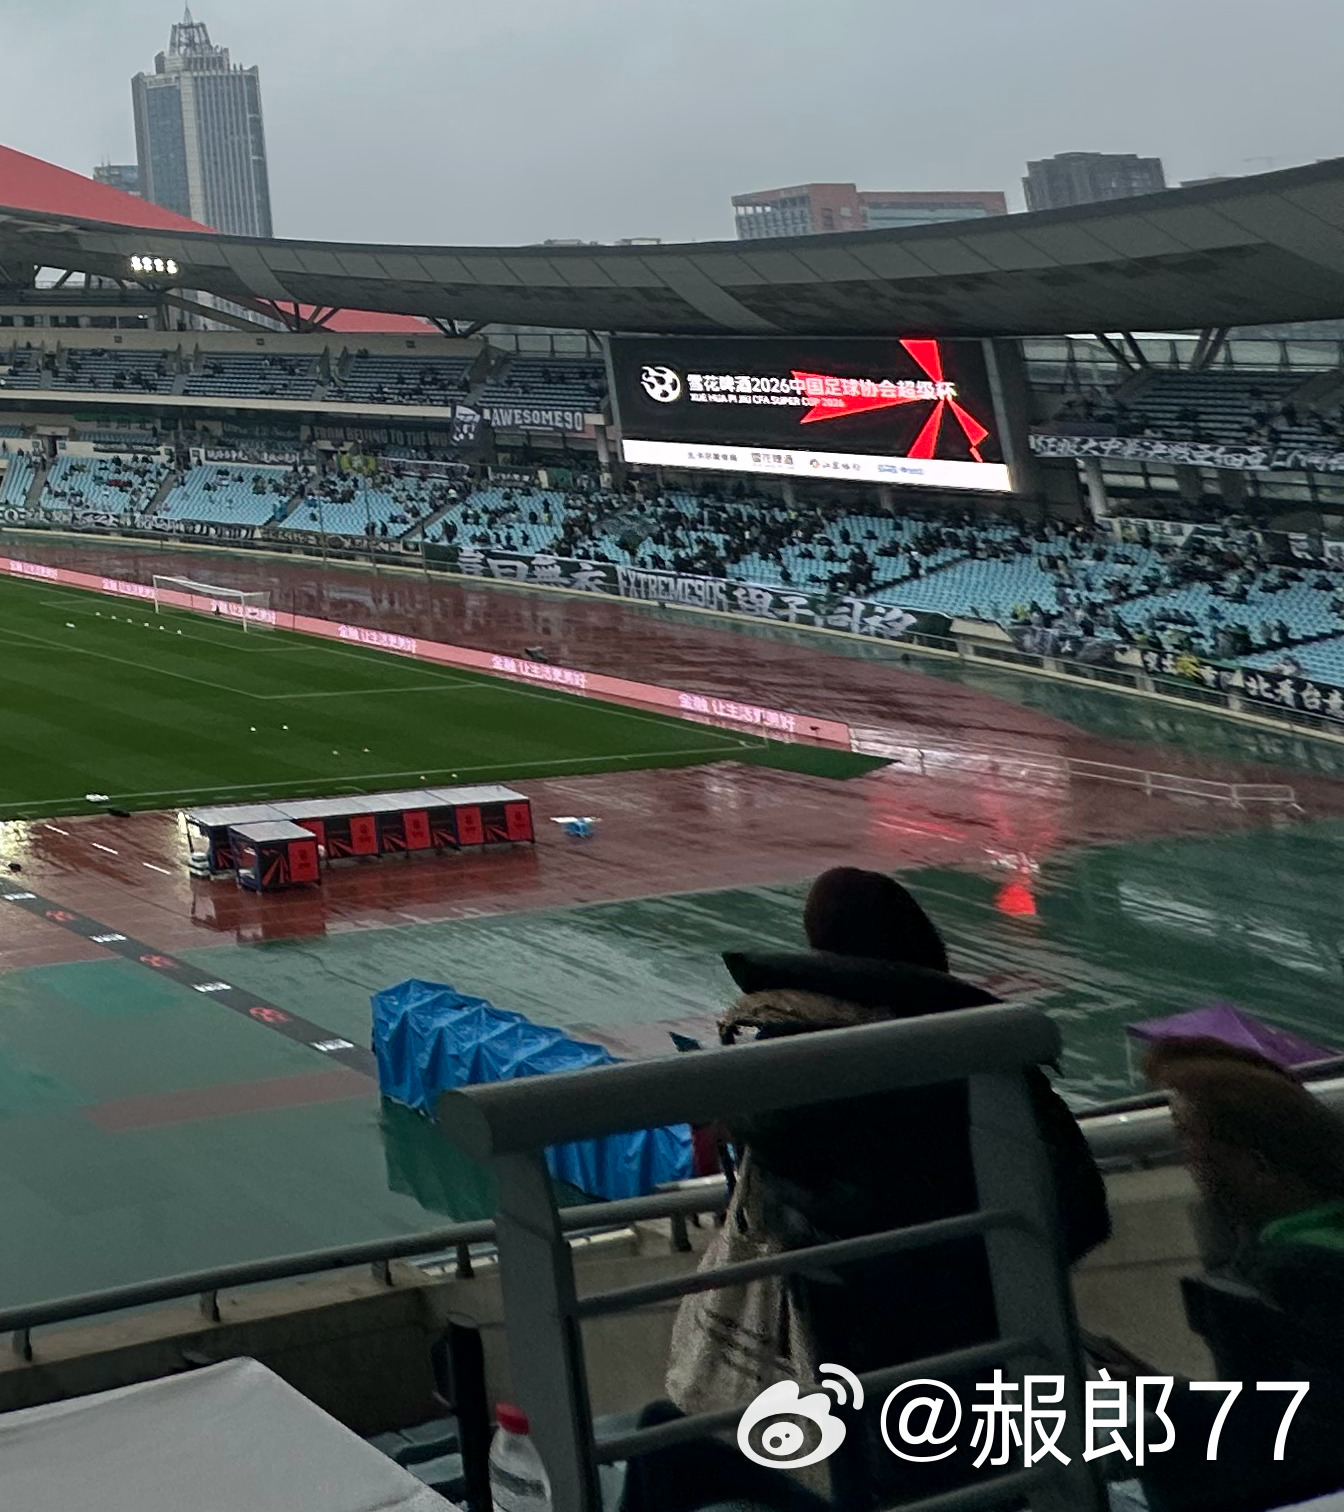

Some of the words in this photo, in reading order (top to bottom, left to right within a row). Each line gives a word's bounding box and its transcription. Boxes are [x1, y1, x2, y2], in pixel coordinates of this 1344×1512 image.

[687, 373, 958, 400] 雪花啤酒2026中国足球协会超级杯
[491, 408, 583, 431] AWESOME90
[313, 425, 344, 440] FROM
[346, 426, 388, 444] BEIJING
[389, 428, 405, 445] TO
[406, 431, 426, 446] THE
